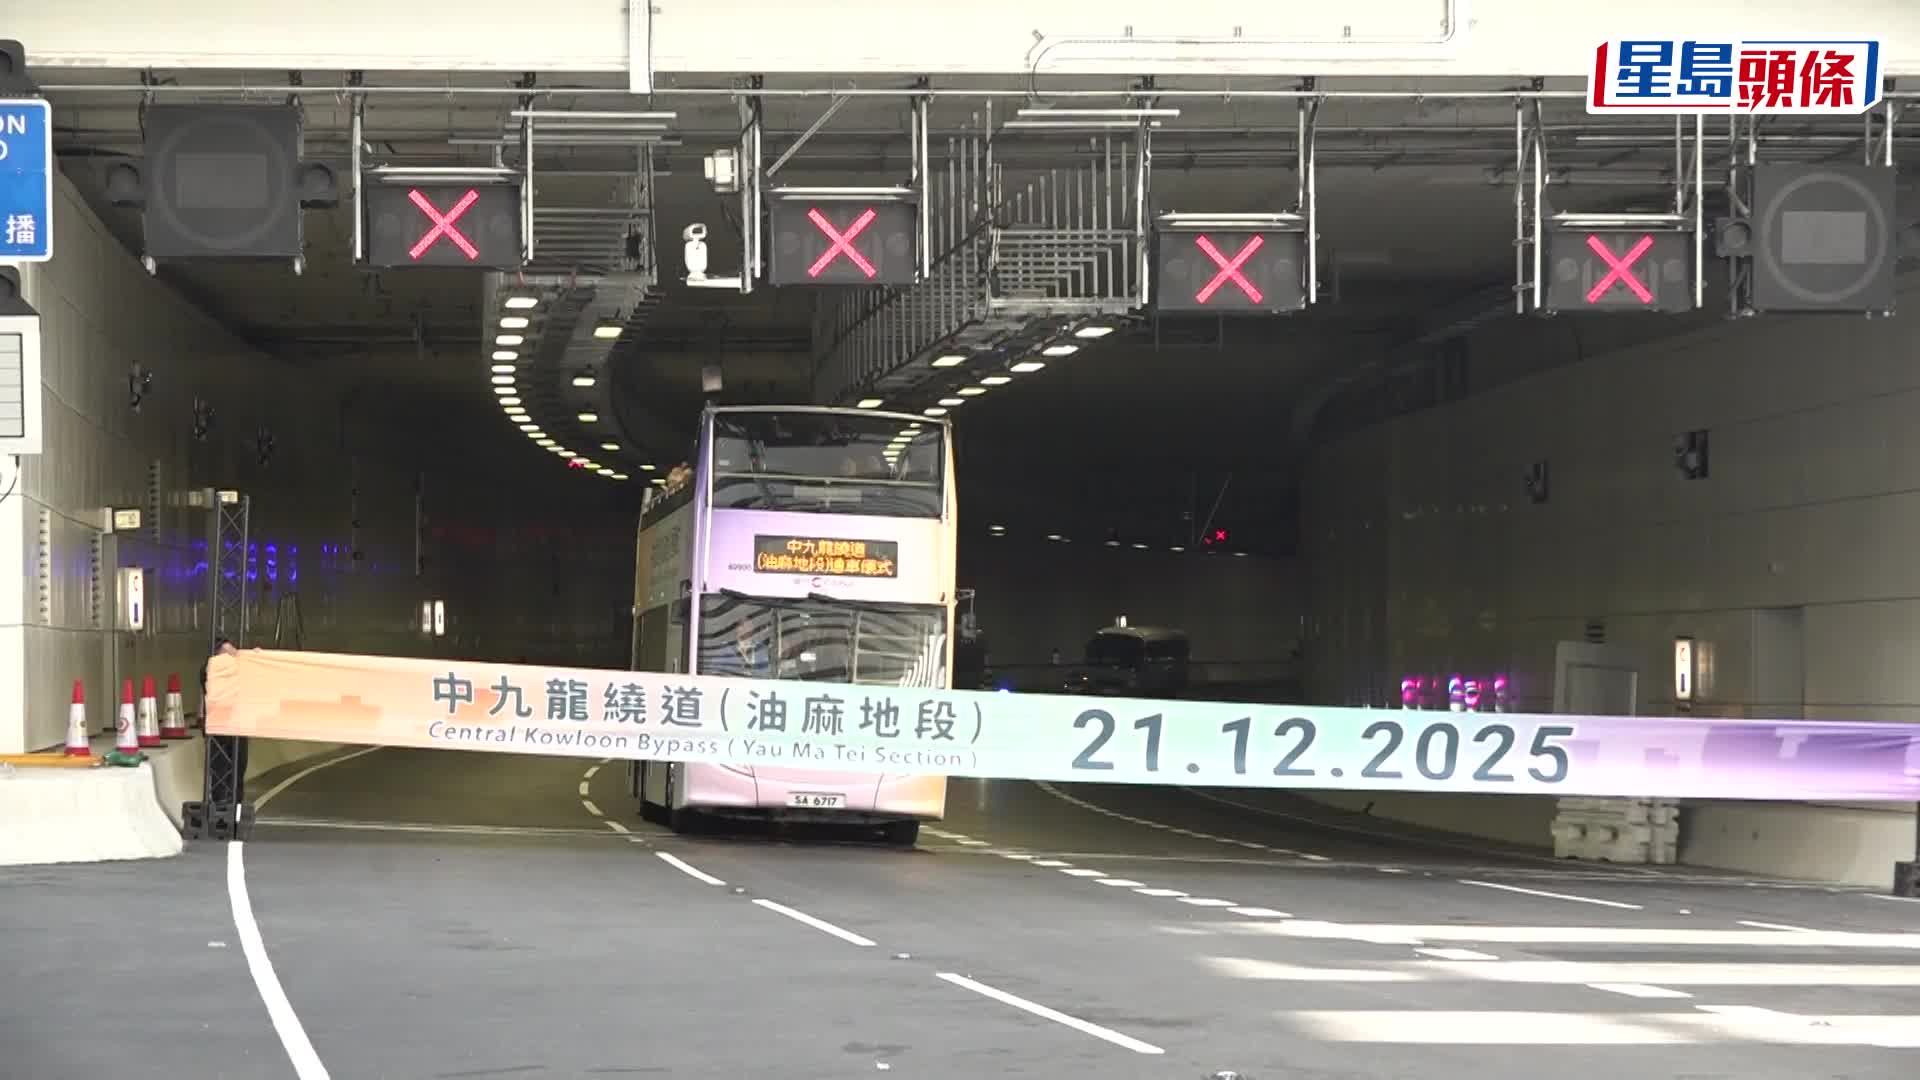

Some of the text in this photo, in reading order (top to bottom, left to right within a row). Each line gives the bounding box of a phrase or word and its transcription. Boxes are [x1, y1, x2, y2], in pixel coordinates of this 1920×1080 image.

[5, 213, 36, 245] 播
[432, 671, 983, 745] 中九龍繞道(油麻地段)
[428, 721, 515, 742] Central
[524, 727, 628, 749] Kowloon
[638, 733, 718, 756] Bypass
[792, 742, 825, 760] Ma
[836, 744, 865, 762] Tei
[1071, 708, 1574, 784] 21.12.2025
[794, 795, 838, 806] SA 6717
